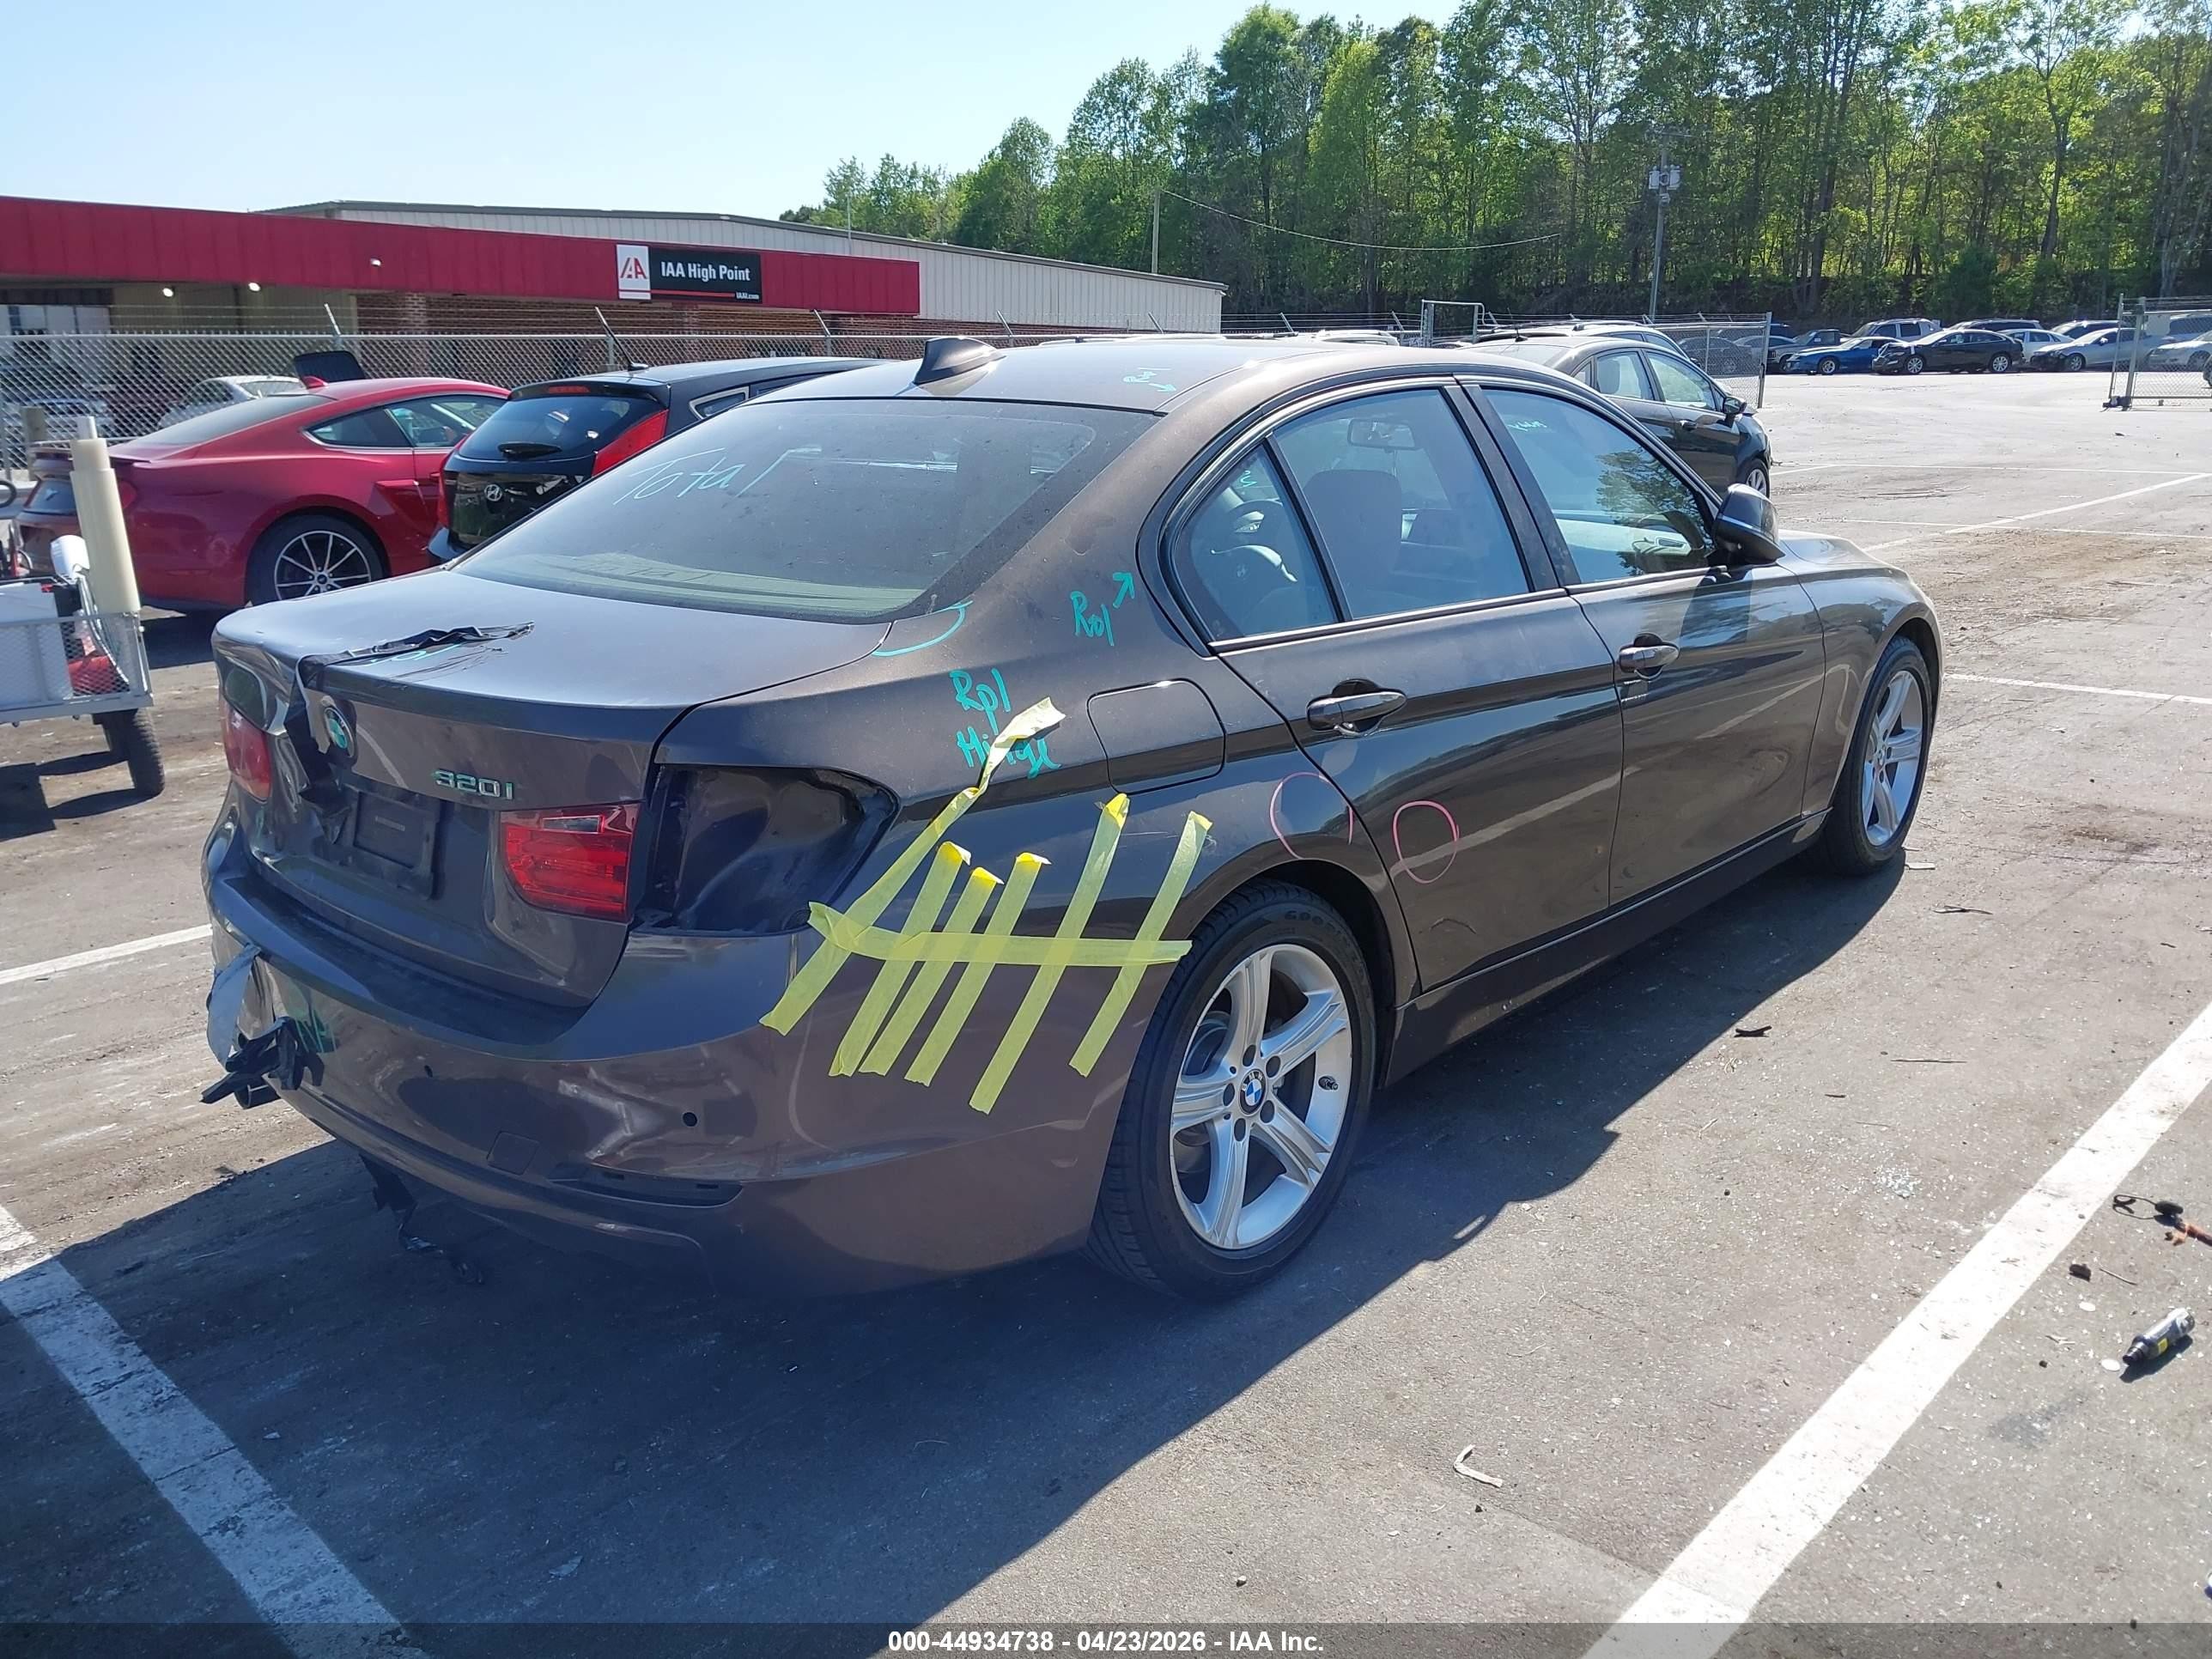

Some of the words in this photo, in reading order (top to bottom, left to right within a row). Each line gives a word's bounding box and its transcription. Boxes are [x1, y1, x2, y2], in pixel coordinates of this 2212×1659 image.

[661, 261, 685, 278] IAA
[688, 263, 716, 283] High
[720, 264, 750, 281] Point
